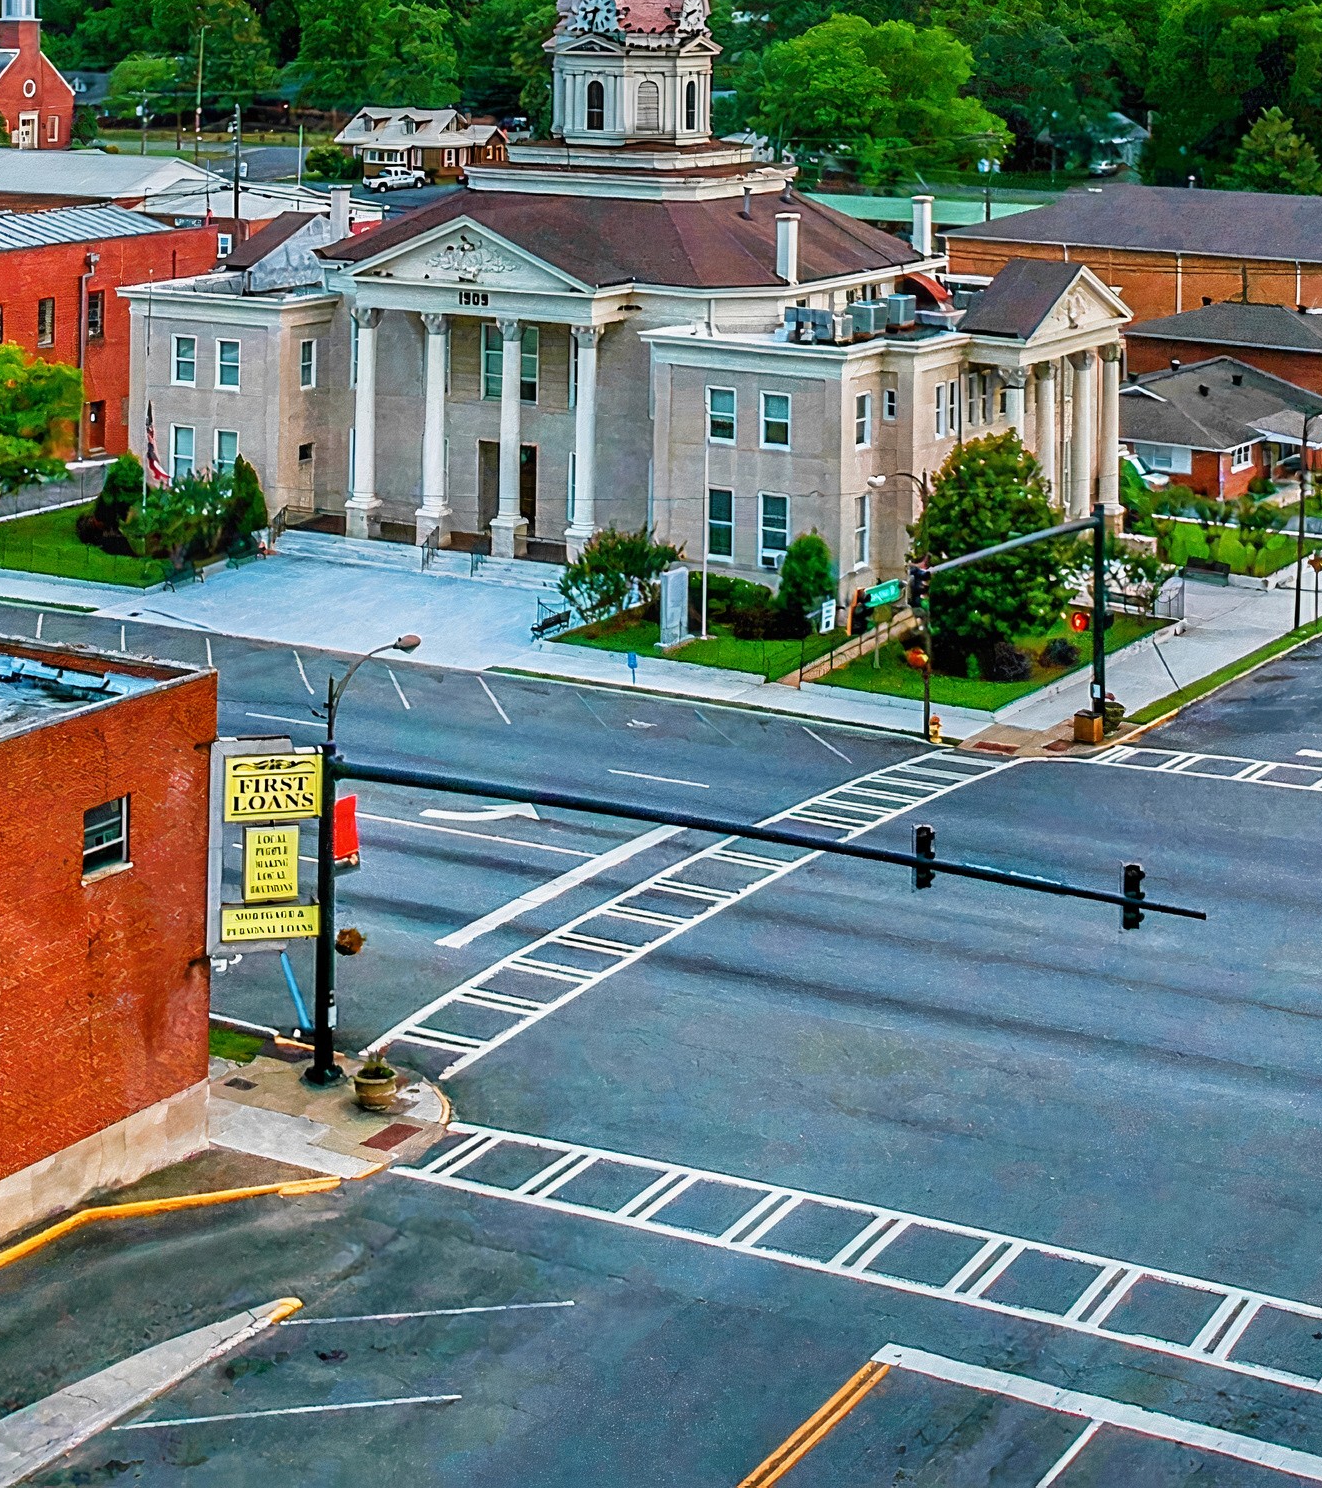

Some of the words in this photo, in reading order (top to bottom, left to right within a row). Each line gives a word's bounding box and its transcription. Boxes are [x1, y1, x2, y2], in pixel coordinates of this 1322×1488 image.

[458, 291, 489, 306] 1909
[239, 776, 309, 794] FIRST
[233, 792, 314, 811] LOANS
[257, 834, 286, 844] LOCAL
[281, 924, 313, 933] LOANS
